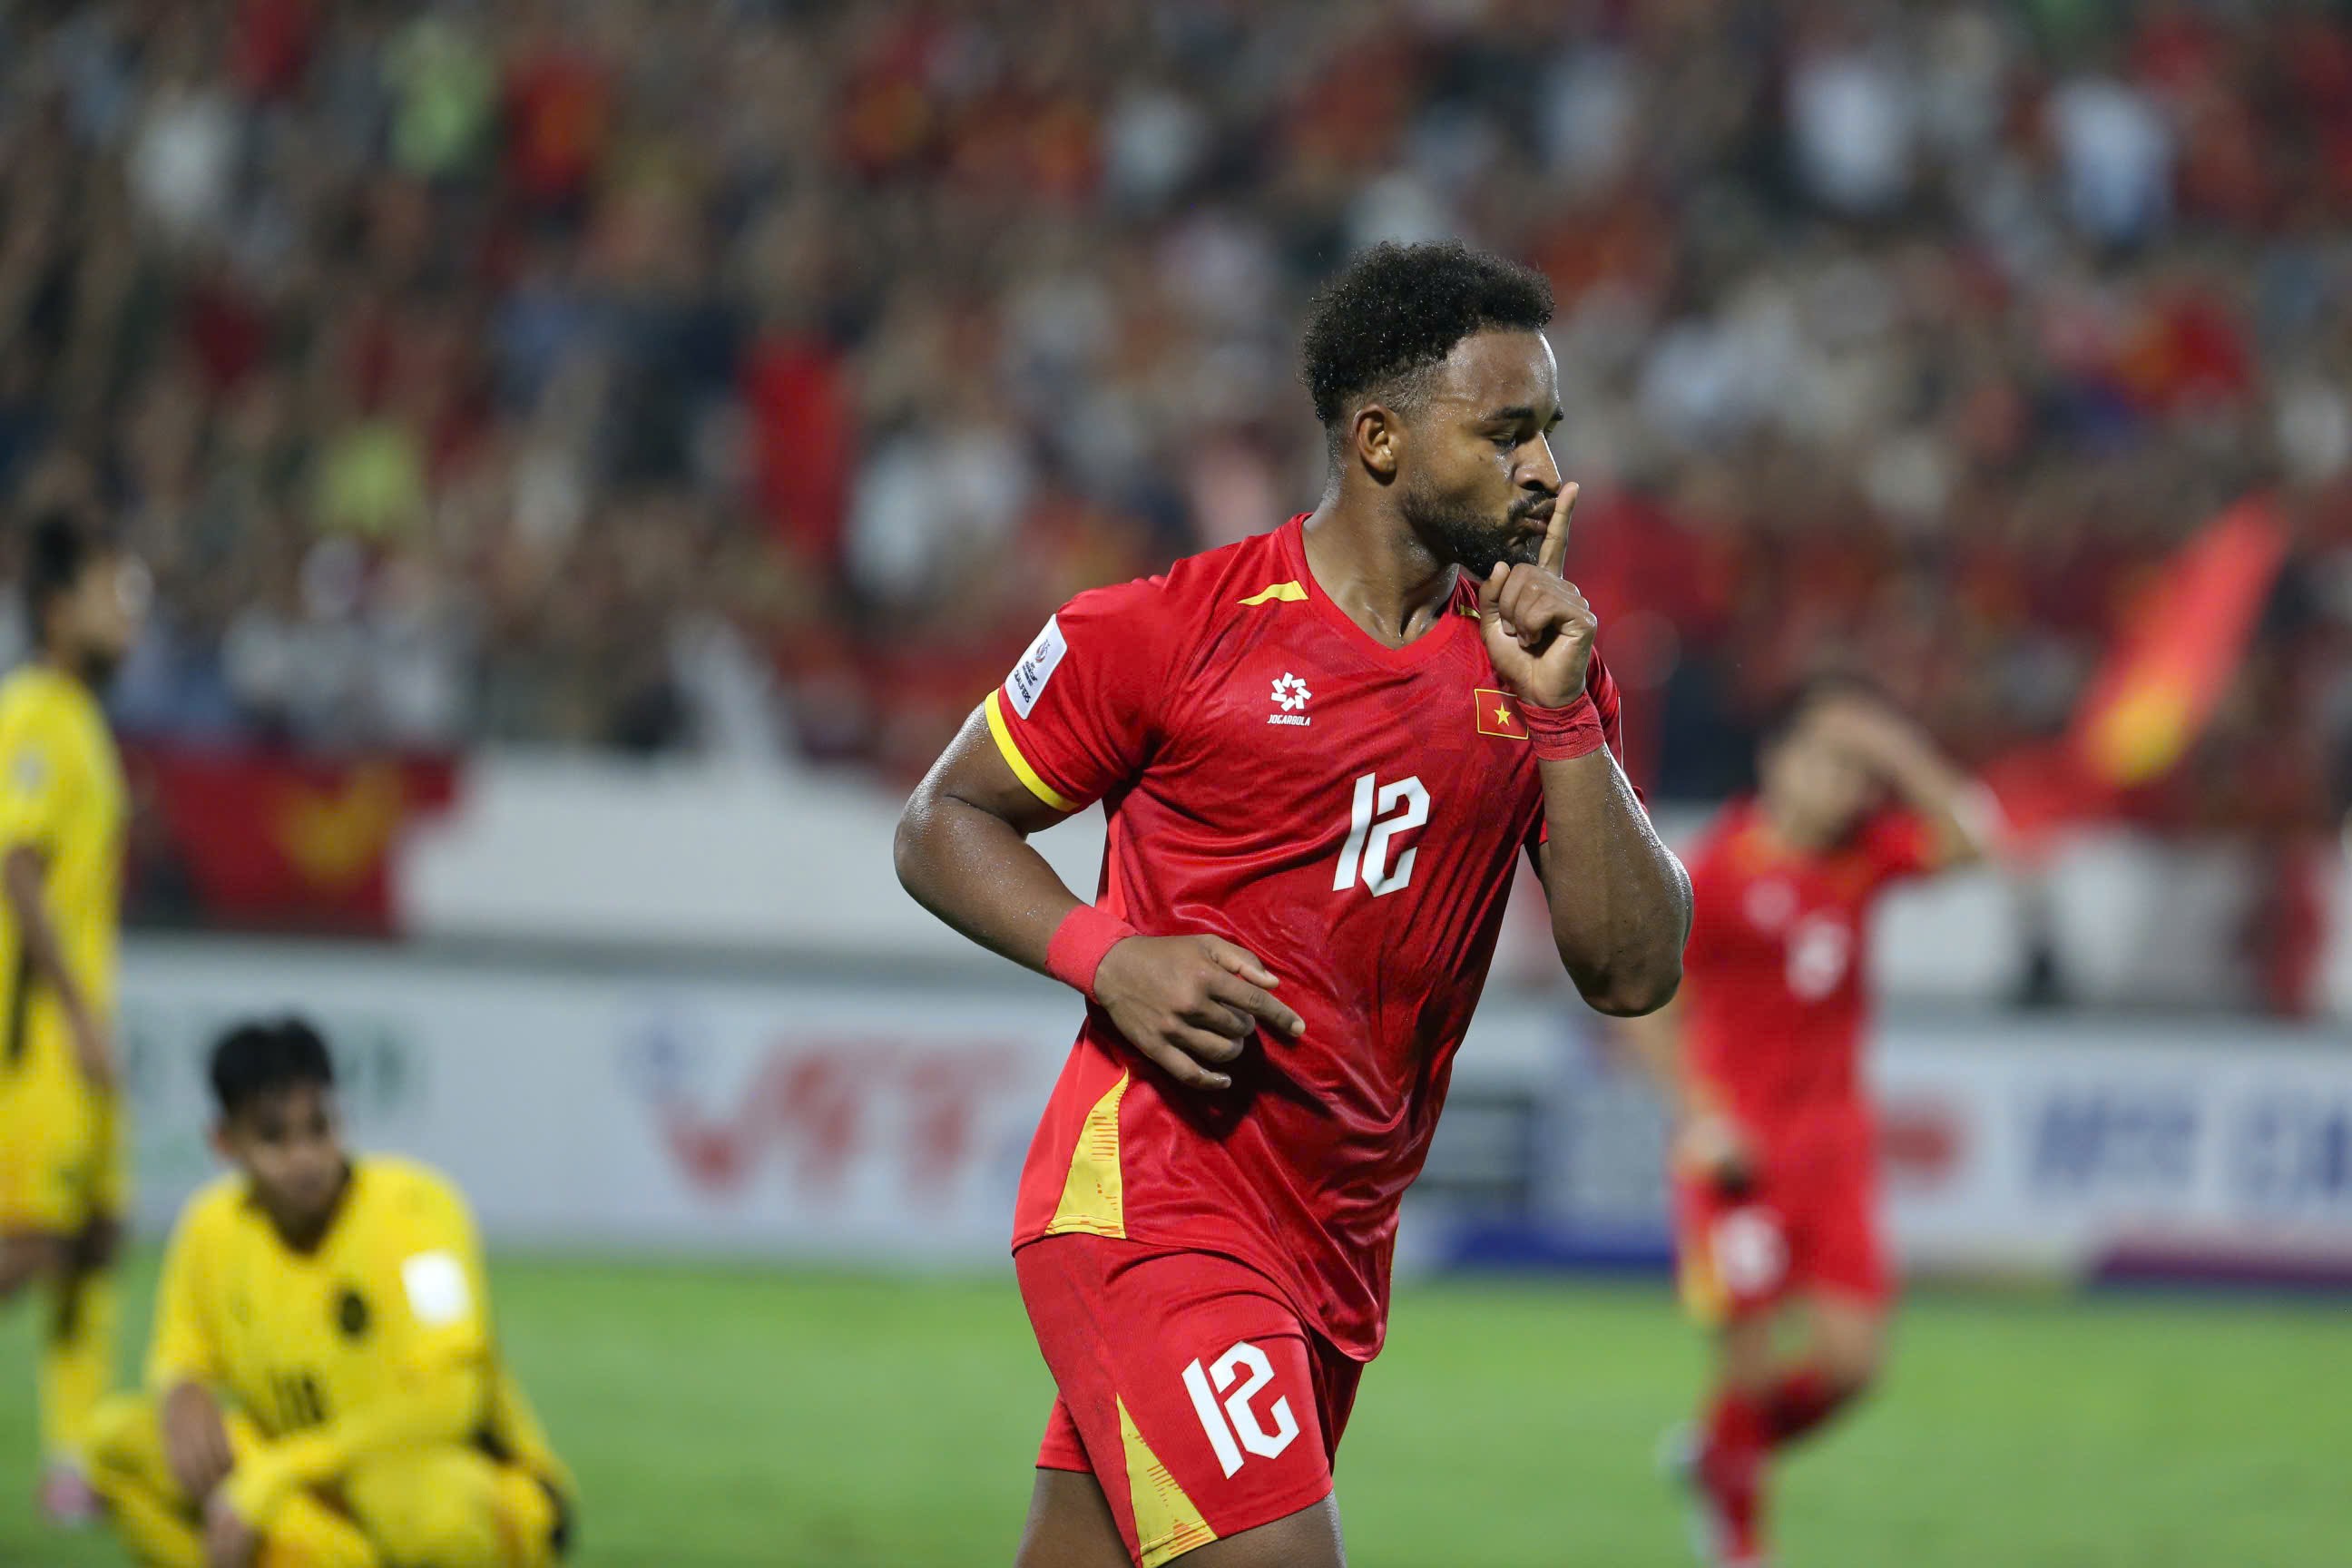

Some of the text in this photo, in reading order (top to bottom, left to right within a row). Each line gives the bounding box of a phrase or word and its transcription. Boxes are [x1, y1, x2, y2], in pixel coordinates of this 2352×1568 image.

[1267, 713, 1311, 727] JOGARBOLA
[1332, 772, 1431, 898] 12
[1181, 1340, 1300, 1480] 12
